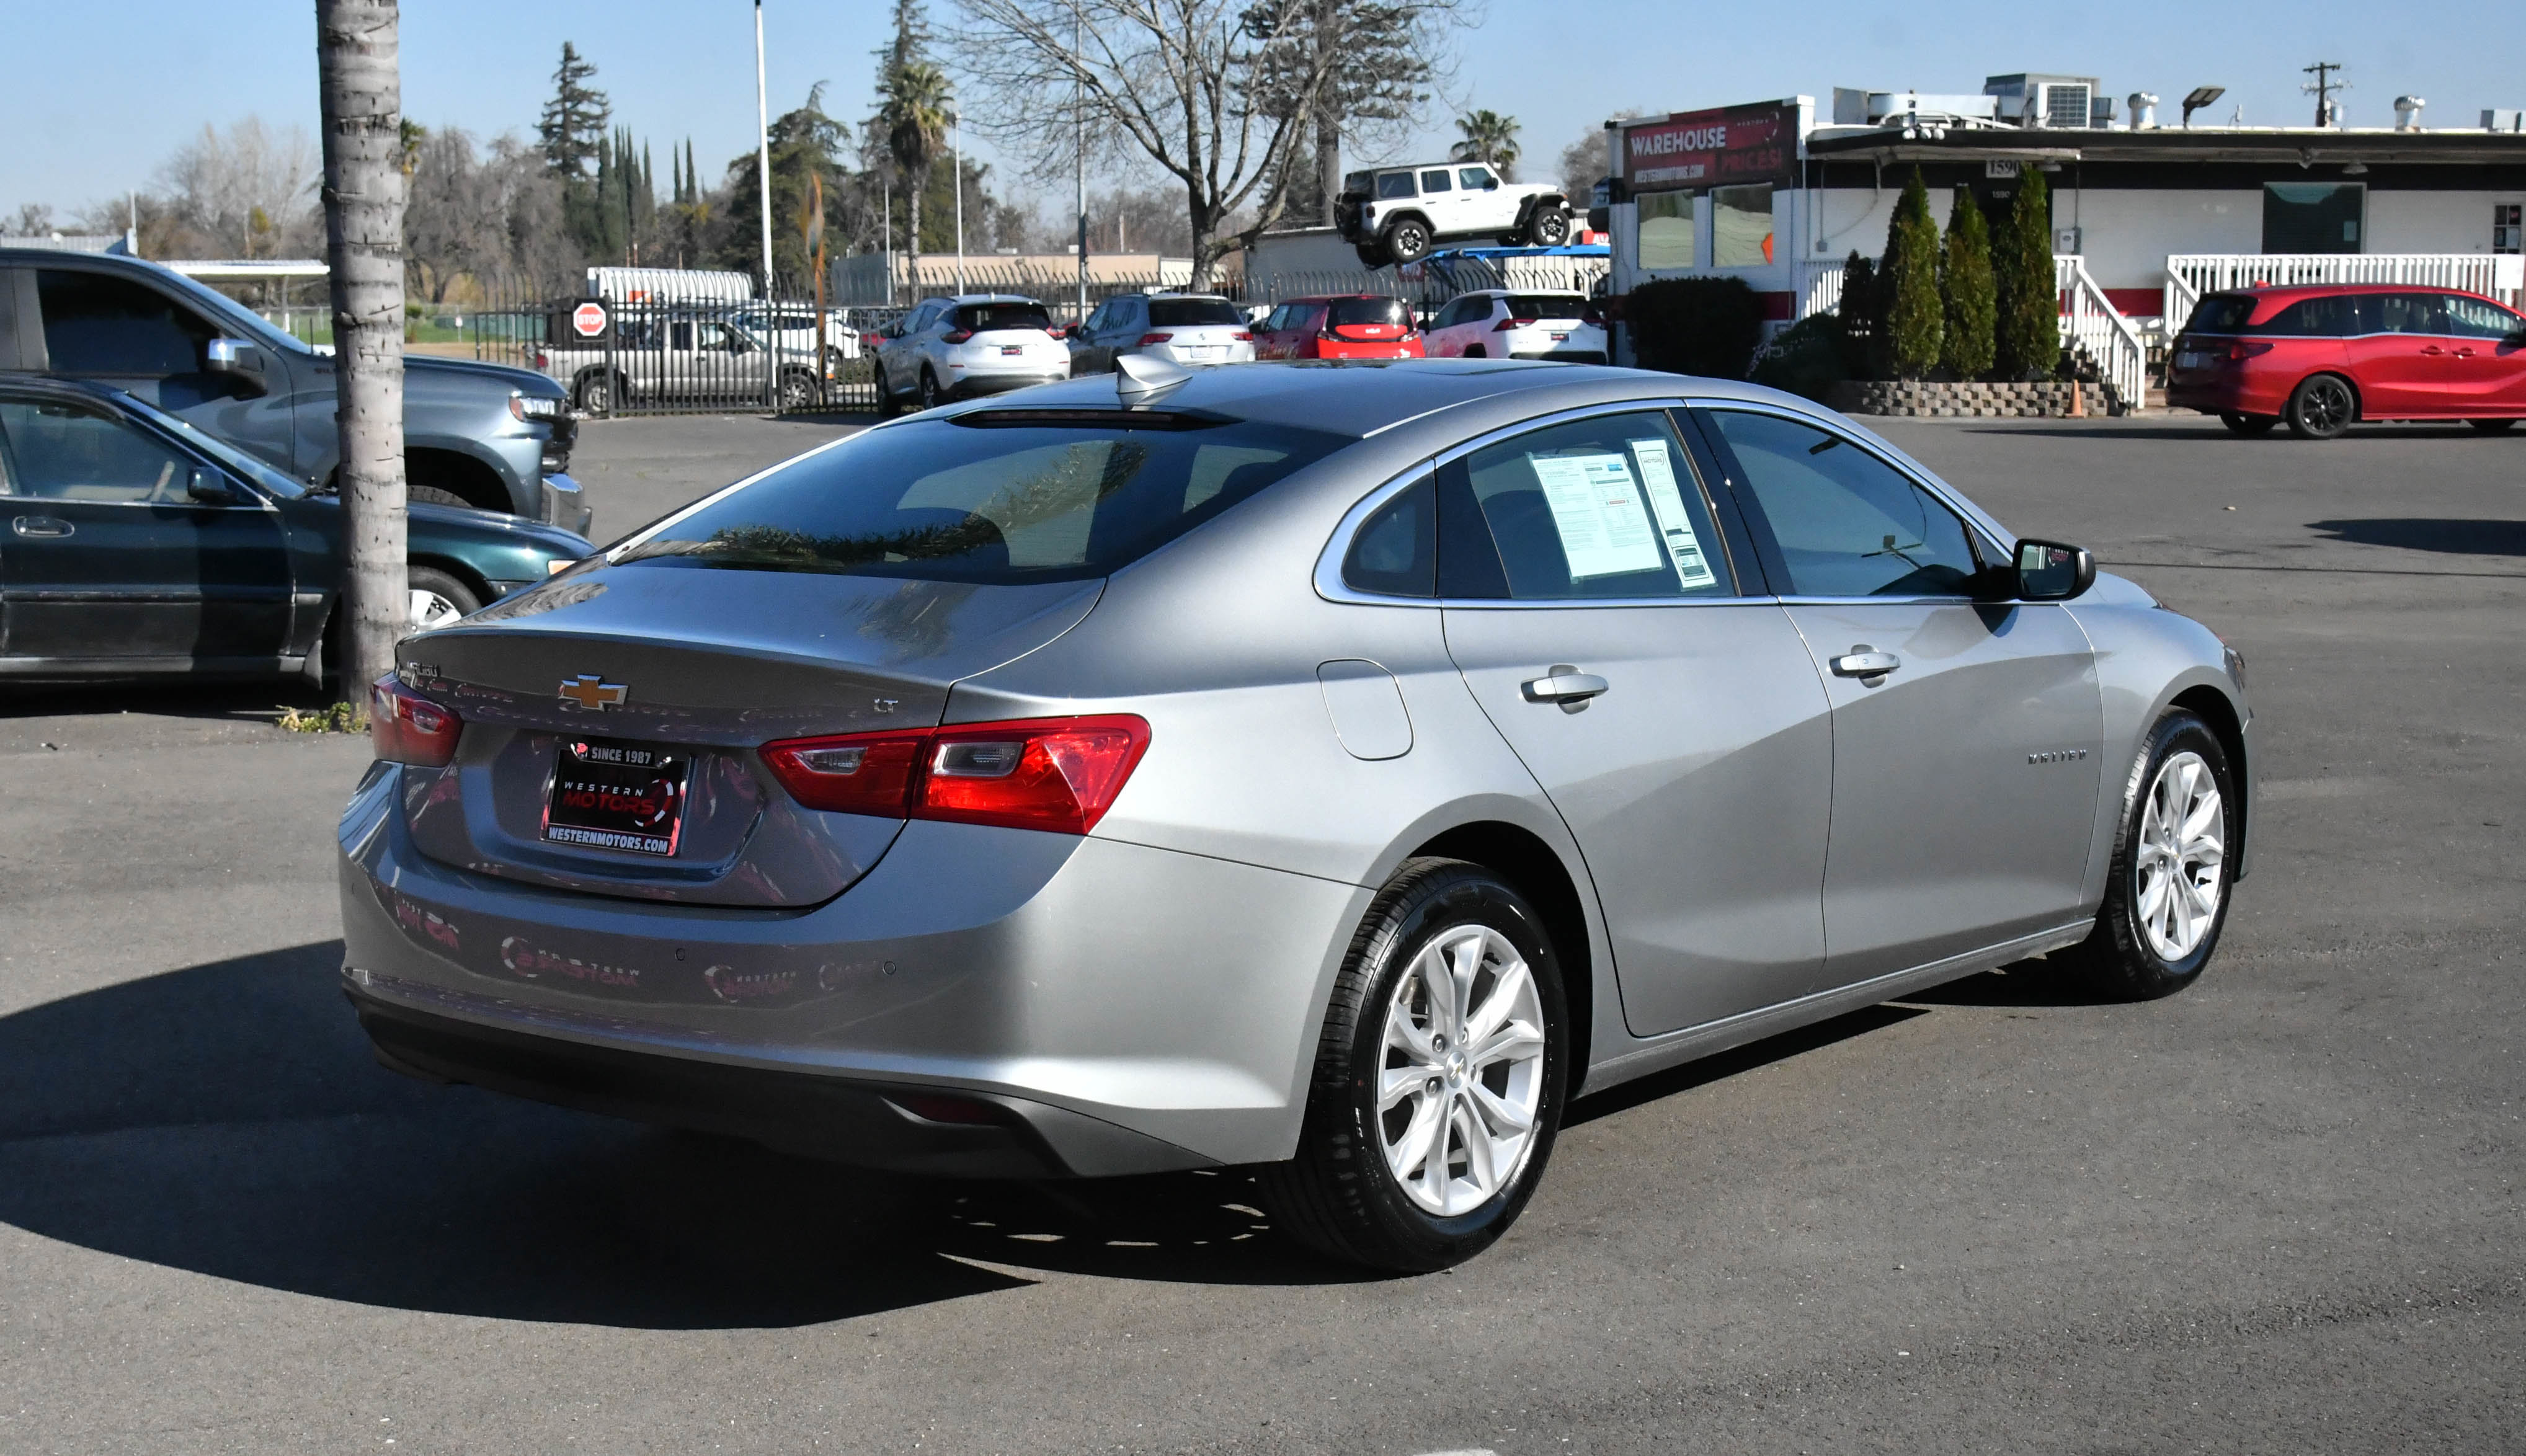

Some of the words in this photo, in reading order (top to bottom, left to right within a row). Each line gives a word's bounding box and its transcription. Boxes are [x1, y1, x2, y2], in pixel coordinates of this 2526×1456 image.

[1630, 126, 1727, 156] WAREHOUSE
[579, 314, 602, 325] STOP
[873, 698, 899, 714] LT
[592, 747, 621, 761] SINCE
[625, 751, 651, 764] 1987
[564, 781, 644, 796] WESTERN
[563, 792, 655, 814] MOTORS
[548, 827, 668, 853] WESTERNMOTORS.COM
